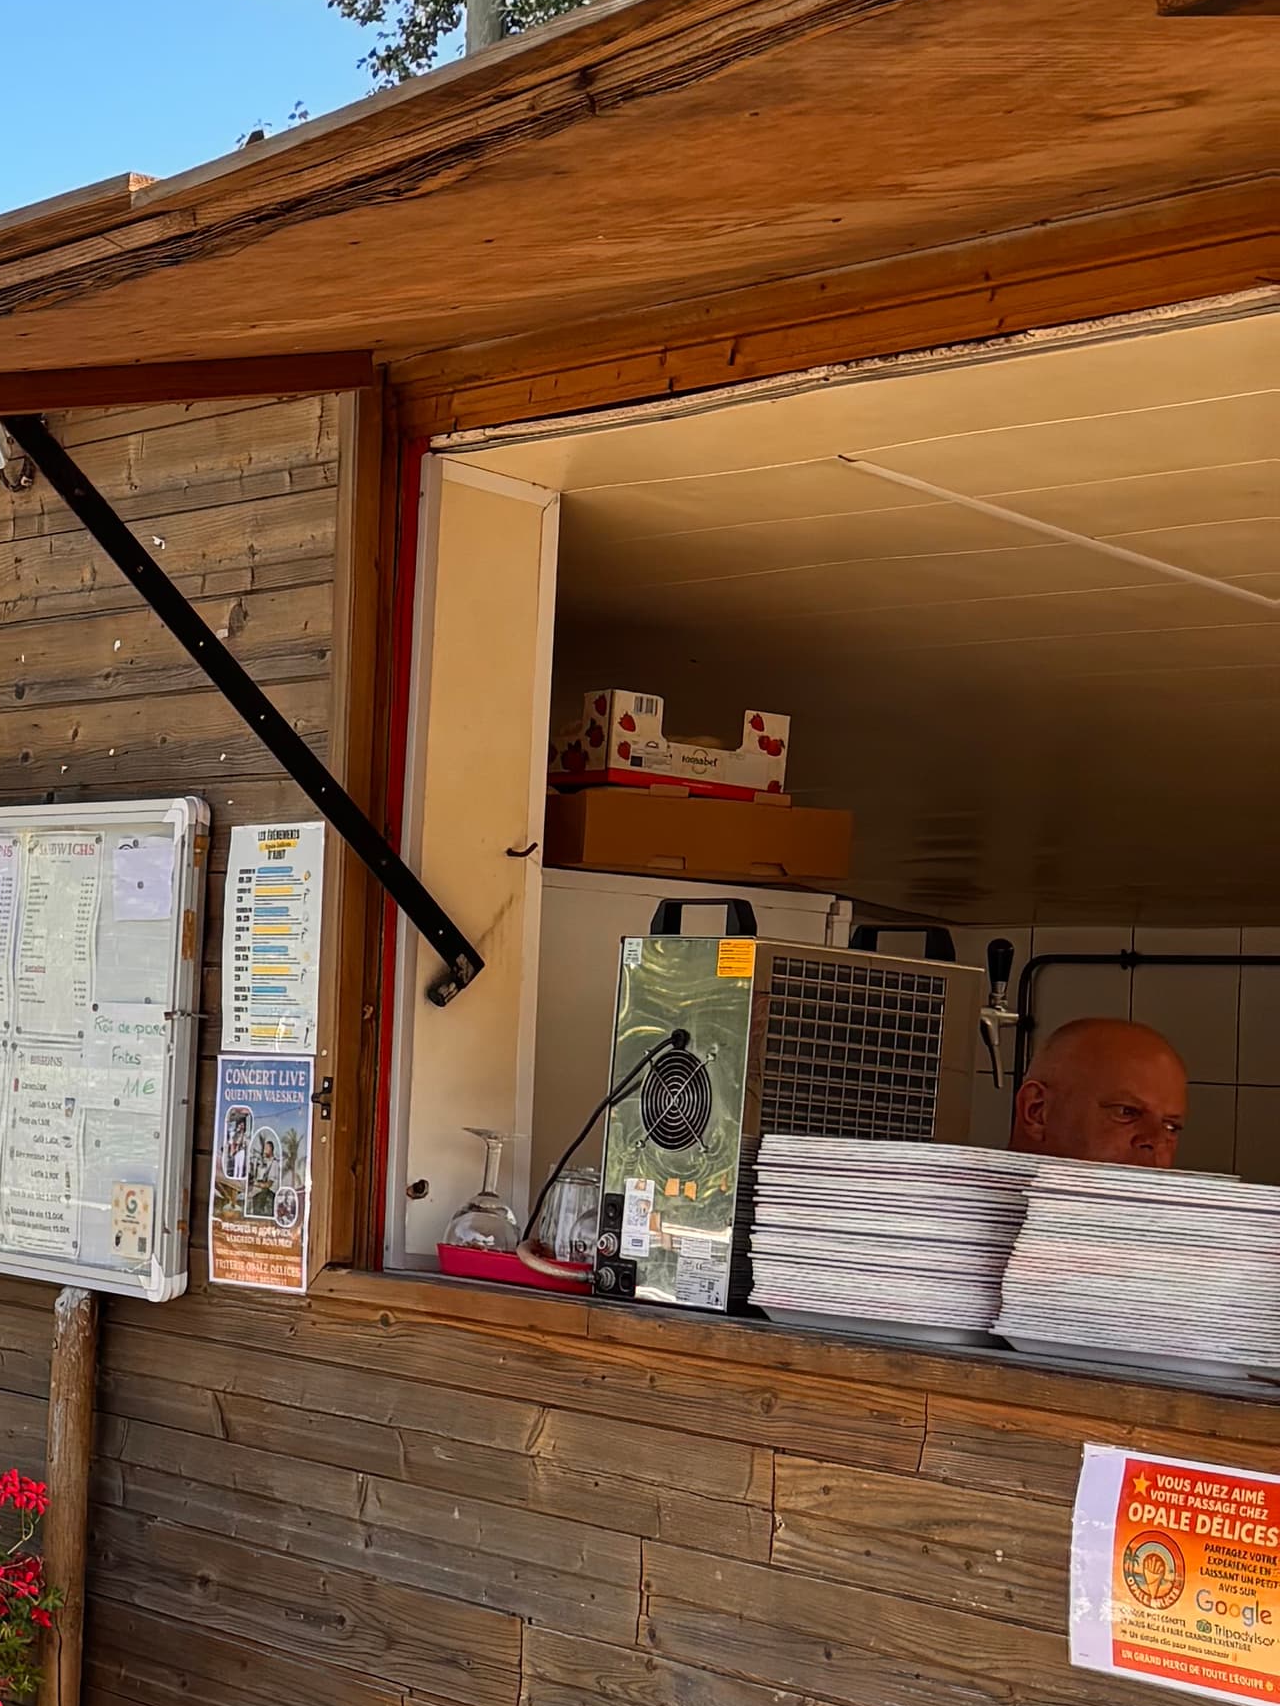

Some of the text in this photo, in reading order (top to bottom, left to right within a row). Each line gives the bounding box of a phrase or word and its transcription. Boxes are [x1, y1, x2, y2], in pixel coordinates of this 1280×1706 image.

[112, 1045, 141, 1065] Frites
[226, 1068, 306, 1086] CONCERT LIVE
[224, 1088, 305, 1103] QUENTIN VAESKEN
[1156, 1474, 1266, 1505] VOUS AVEZ AIMÉ
[1150, 1489, 1270, 1521] VOTRE PASSAGE CHEZ
[1128, 1502, 1280, 1548] OPALE DÉLICES
[1204, 1543, 1278, 1566] PARTAGEZ VOTRE
[1200, 1566, 1278, 1589] LAISSANT UN PETIT
[1260, 1566, 1272, 1576] EN
[1219, 1583, 1257, 1597] AVIS SUR
[1196, 1589, 1273, 1627] Google
[1214, 1624, 1276, 1647] Tripadvisor
[1122, 1650, 1133, 1660] UN
[1134, 1651, 1161, 1666] GRAND
[1163, 1657, 1187, 1671] MERCI
[1190, 1664, 1200, 1675] DE
[1202, 1667, 1228, 1681] TOUTE
